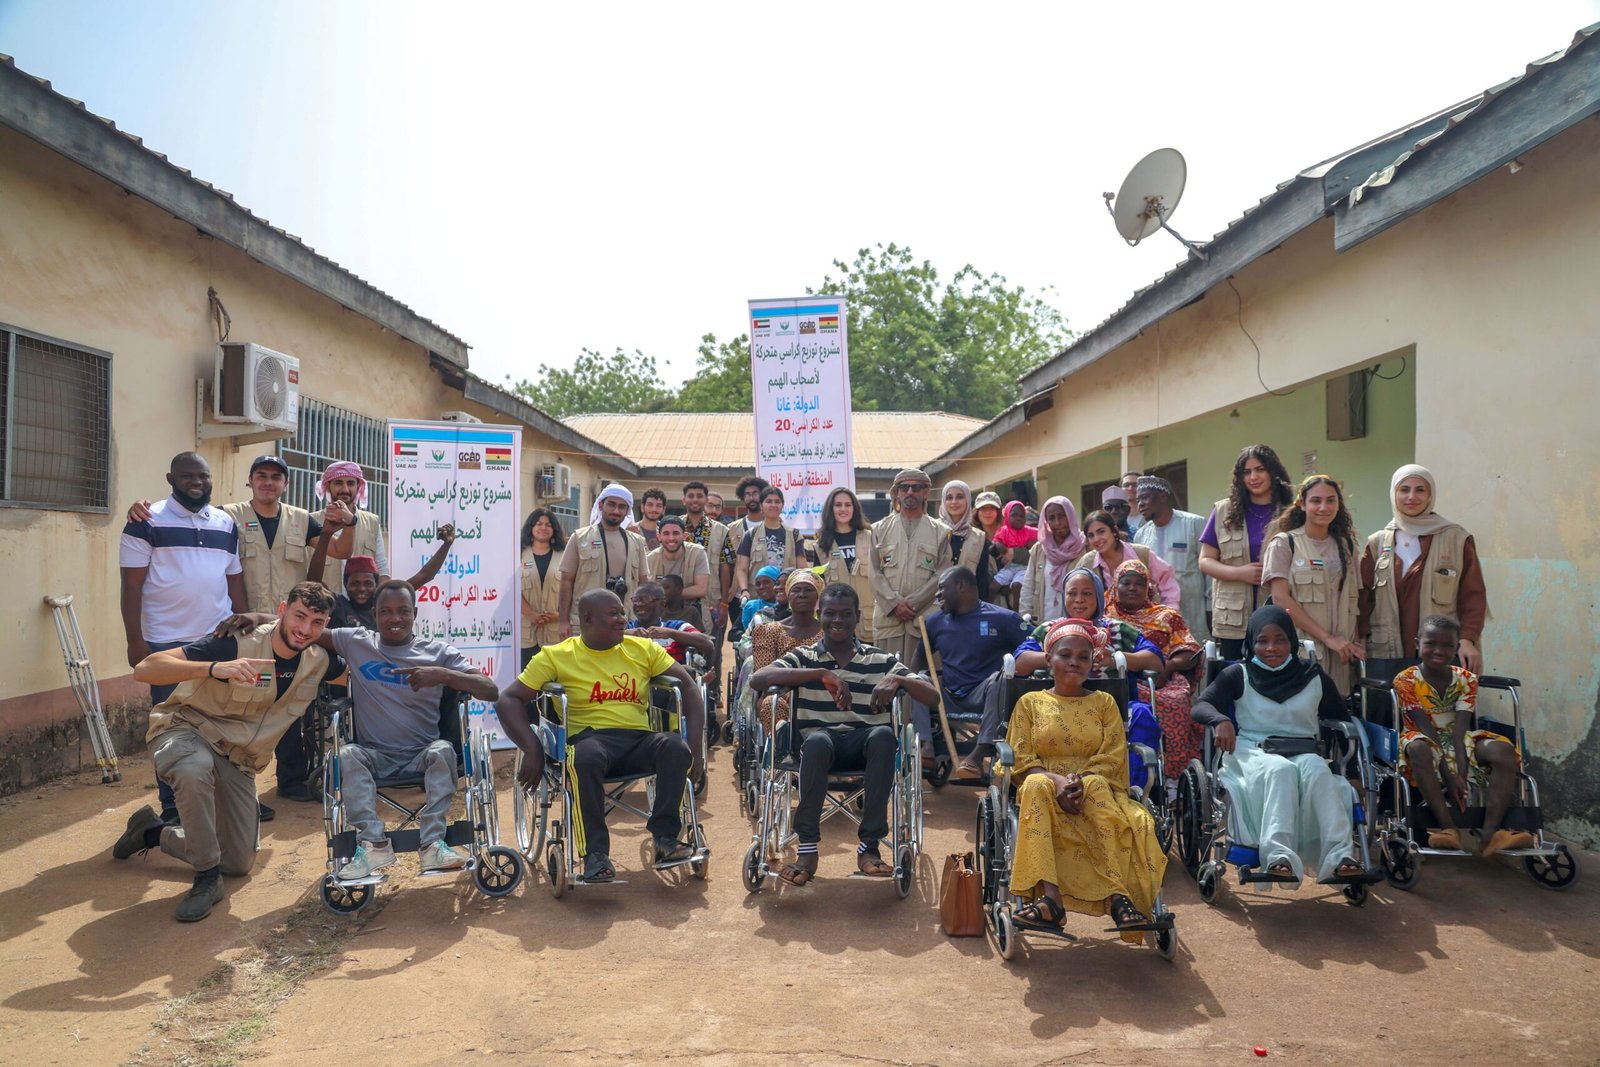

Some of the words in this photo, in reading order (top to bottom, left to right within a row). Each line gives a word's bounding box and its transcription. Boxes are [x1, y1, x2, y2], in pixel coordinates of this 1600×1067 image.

[755, 343, 777, 361] متحركة
[779, 342, 800, 364] كراسي
[801, 342, 817, 364] توزيع
[819, 340, 840, 363] مشروع
[289, 373, 297, 381] TCL
[768, 371, 788, 392] الهمم
[790, 368, 820, 389] لأصحاب
[776, 396, 791, 411] غانا
[793, 395, 819, 414] الدولة:
[775, 419, 791, 431] 20
[792, 417, 819, 437] الكراسي:
[822, 418, 833, 430] عدد
[760, 443, 777, 462] الخيرية
[779, 443, 796, 461] الشارقة
[798, 443, 813, 460] جمعية
[827, 442, 845, 459] التمويل:
[770, 472, 782, 488] غانا
[784, 471, 804, 491] شمال
[805, 470, 833, 487] المنطقة:
[394, 477, 426, 502] متحركة
[428, 479, 457, 510] كراسي
[459, 482, 481, 511] توزيع
[483, 480, 512, 511] مشروع
[444, 554, 480, 579] الدولة:
[418, 585, 440, 602] 20
[441, 584, 479, 610] الكراسي:
[482, 587, 498, 601] عدد
[422, 619, 446, 642] الشارقة
[448, 618, 467, 643] جمعية
[470, 617, 485, 642] الوفد
[488, 618, 513, 642] التمويل:
